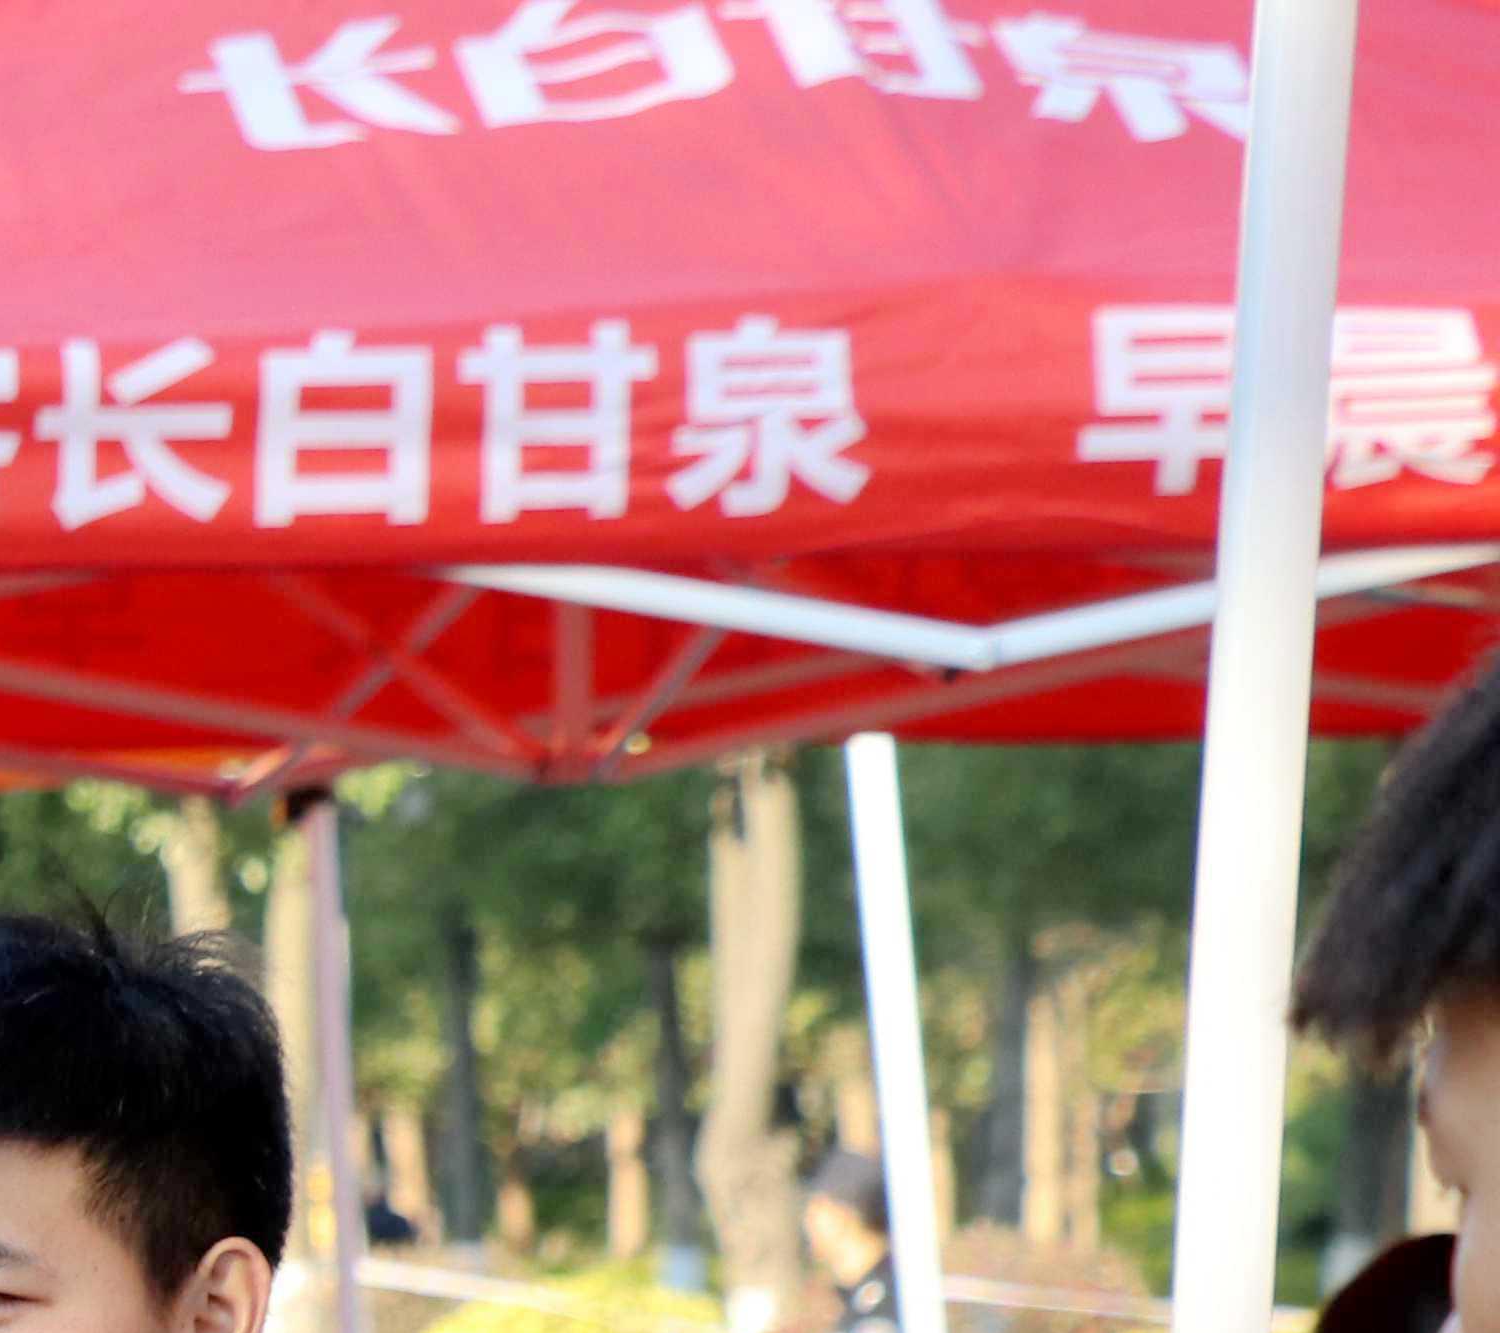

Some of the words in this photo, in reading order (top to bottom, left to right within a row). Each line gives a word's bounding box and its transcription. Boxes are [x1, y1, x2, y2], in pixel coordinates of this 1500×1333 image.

[178, 0, 1252, 150] 长白甘泉
[1076, 305, 1498, 496] 早晨
